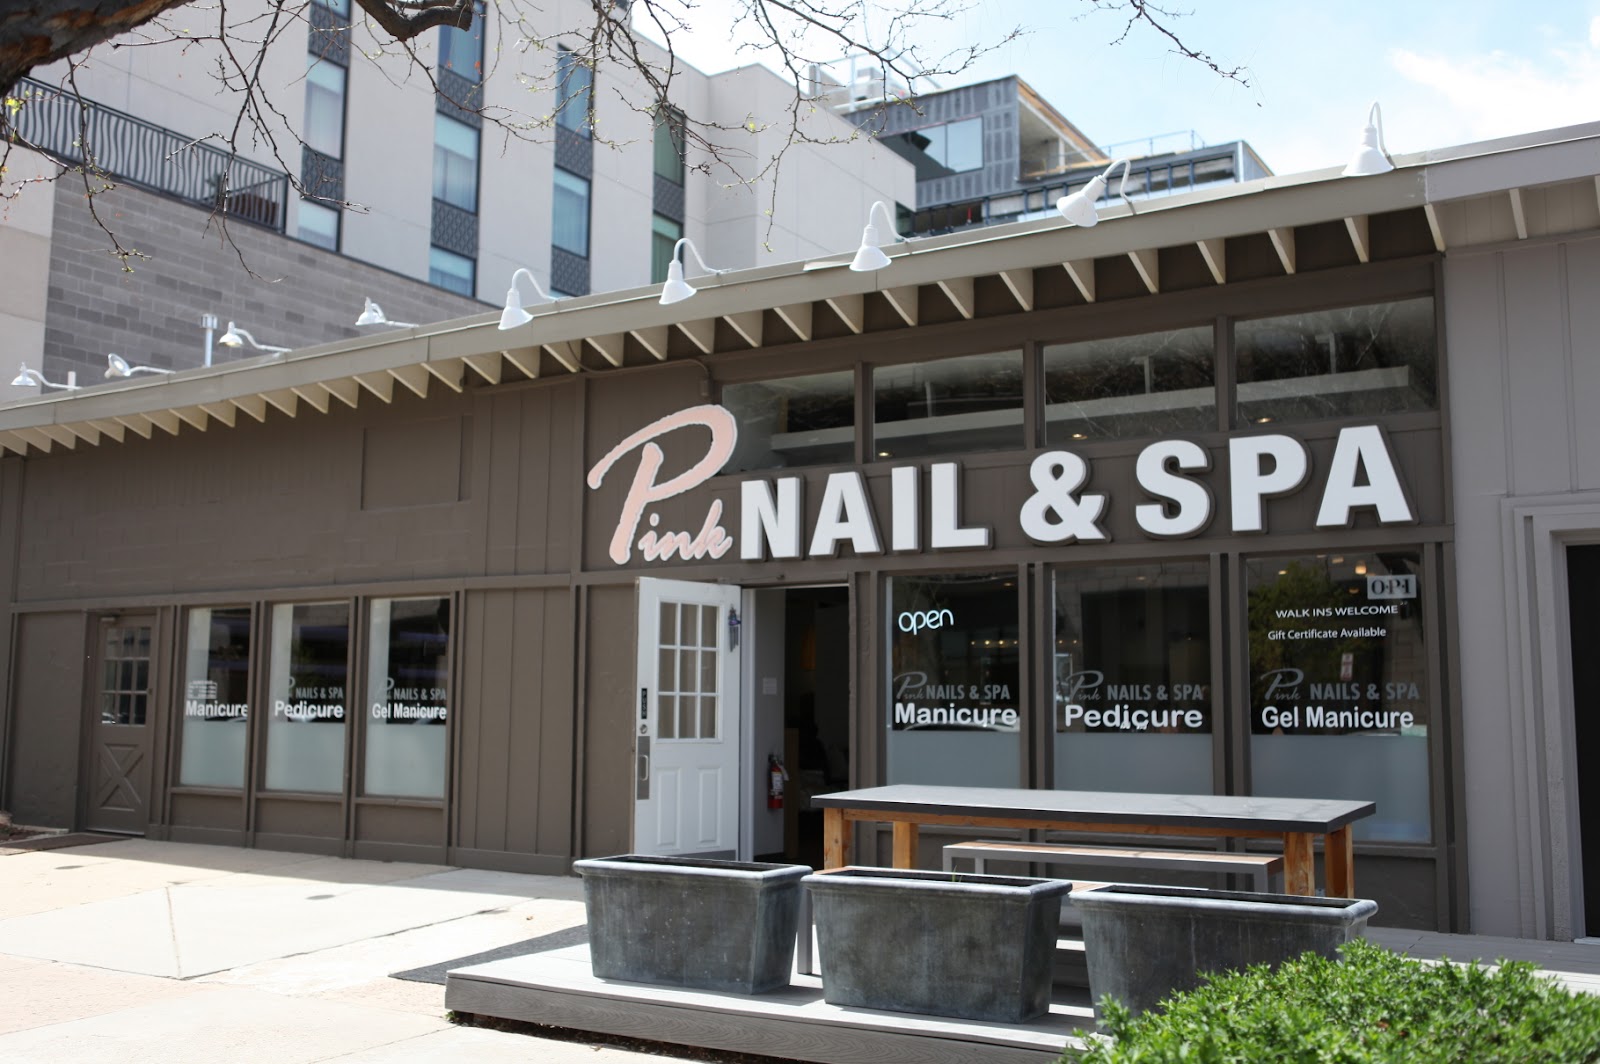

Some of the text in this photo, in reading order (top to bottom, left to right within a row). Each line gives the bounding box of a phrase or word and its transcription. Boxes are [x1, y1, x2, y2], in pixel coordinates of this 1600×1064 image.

[587, 404, 1413, 565] Pink NAIL & SPA
[898, 609, 955, 635] open
[1276, 605, 1399, 618] WALK INS WELCOME
[1268, 627, 1387, 640] Gift Certificate Available
[295, 686, 319, 699] NAILS
[320, 687, 327, 699] &
[328, 686, 344, 699] SPA
[393, 688, 418, 700] NAILS
[420, 687, 428, 700] &
[430, 687, 447, 700] SPA
[893, 671, 1011, 700] Pink NAILS & SPA
[1065, 670, 1204, 701] Pink NAILS & SPA
[1260, 668, 1420, 700] Pink NAILS & SPA
[185, 700, 248, 717] Manicure
[274, 700, 344, 718] Pedicure
[372, 702, 447, 720] Gel Manicure
[895, 702, 1017, 725] Manicure
[1065, 704, 1203, 728] Pedicure
[1262, 706, 1414, 728] Gel Manicure
